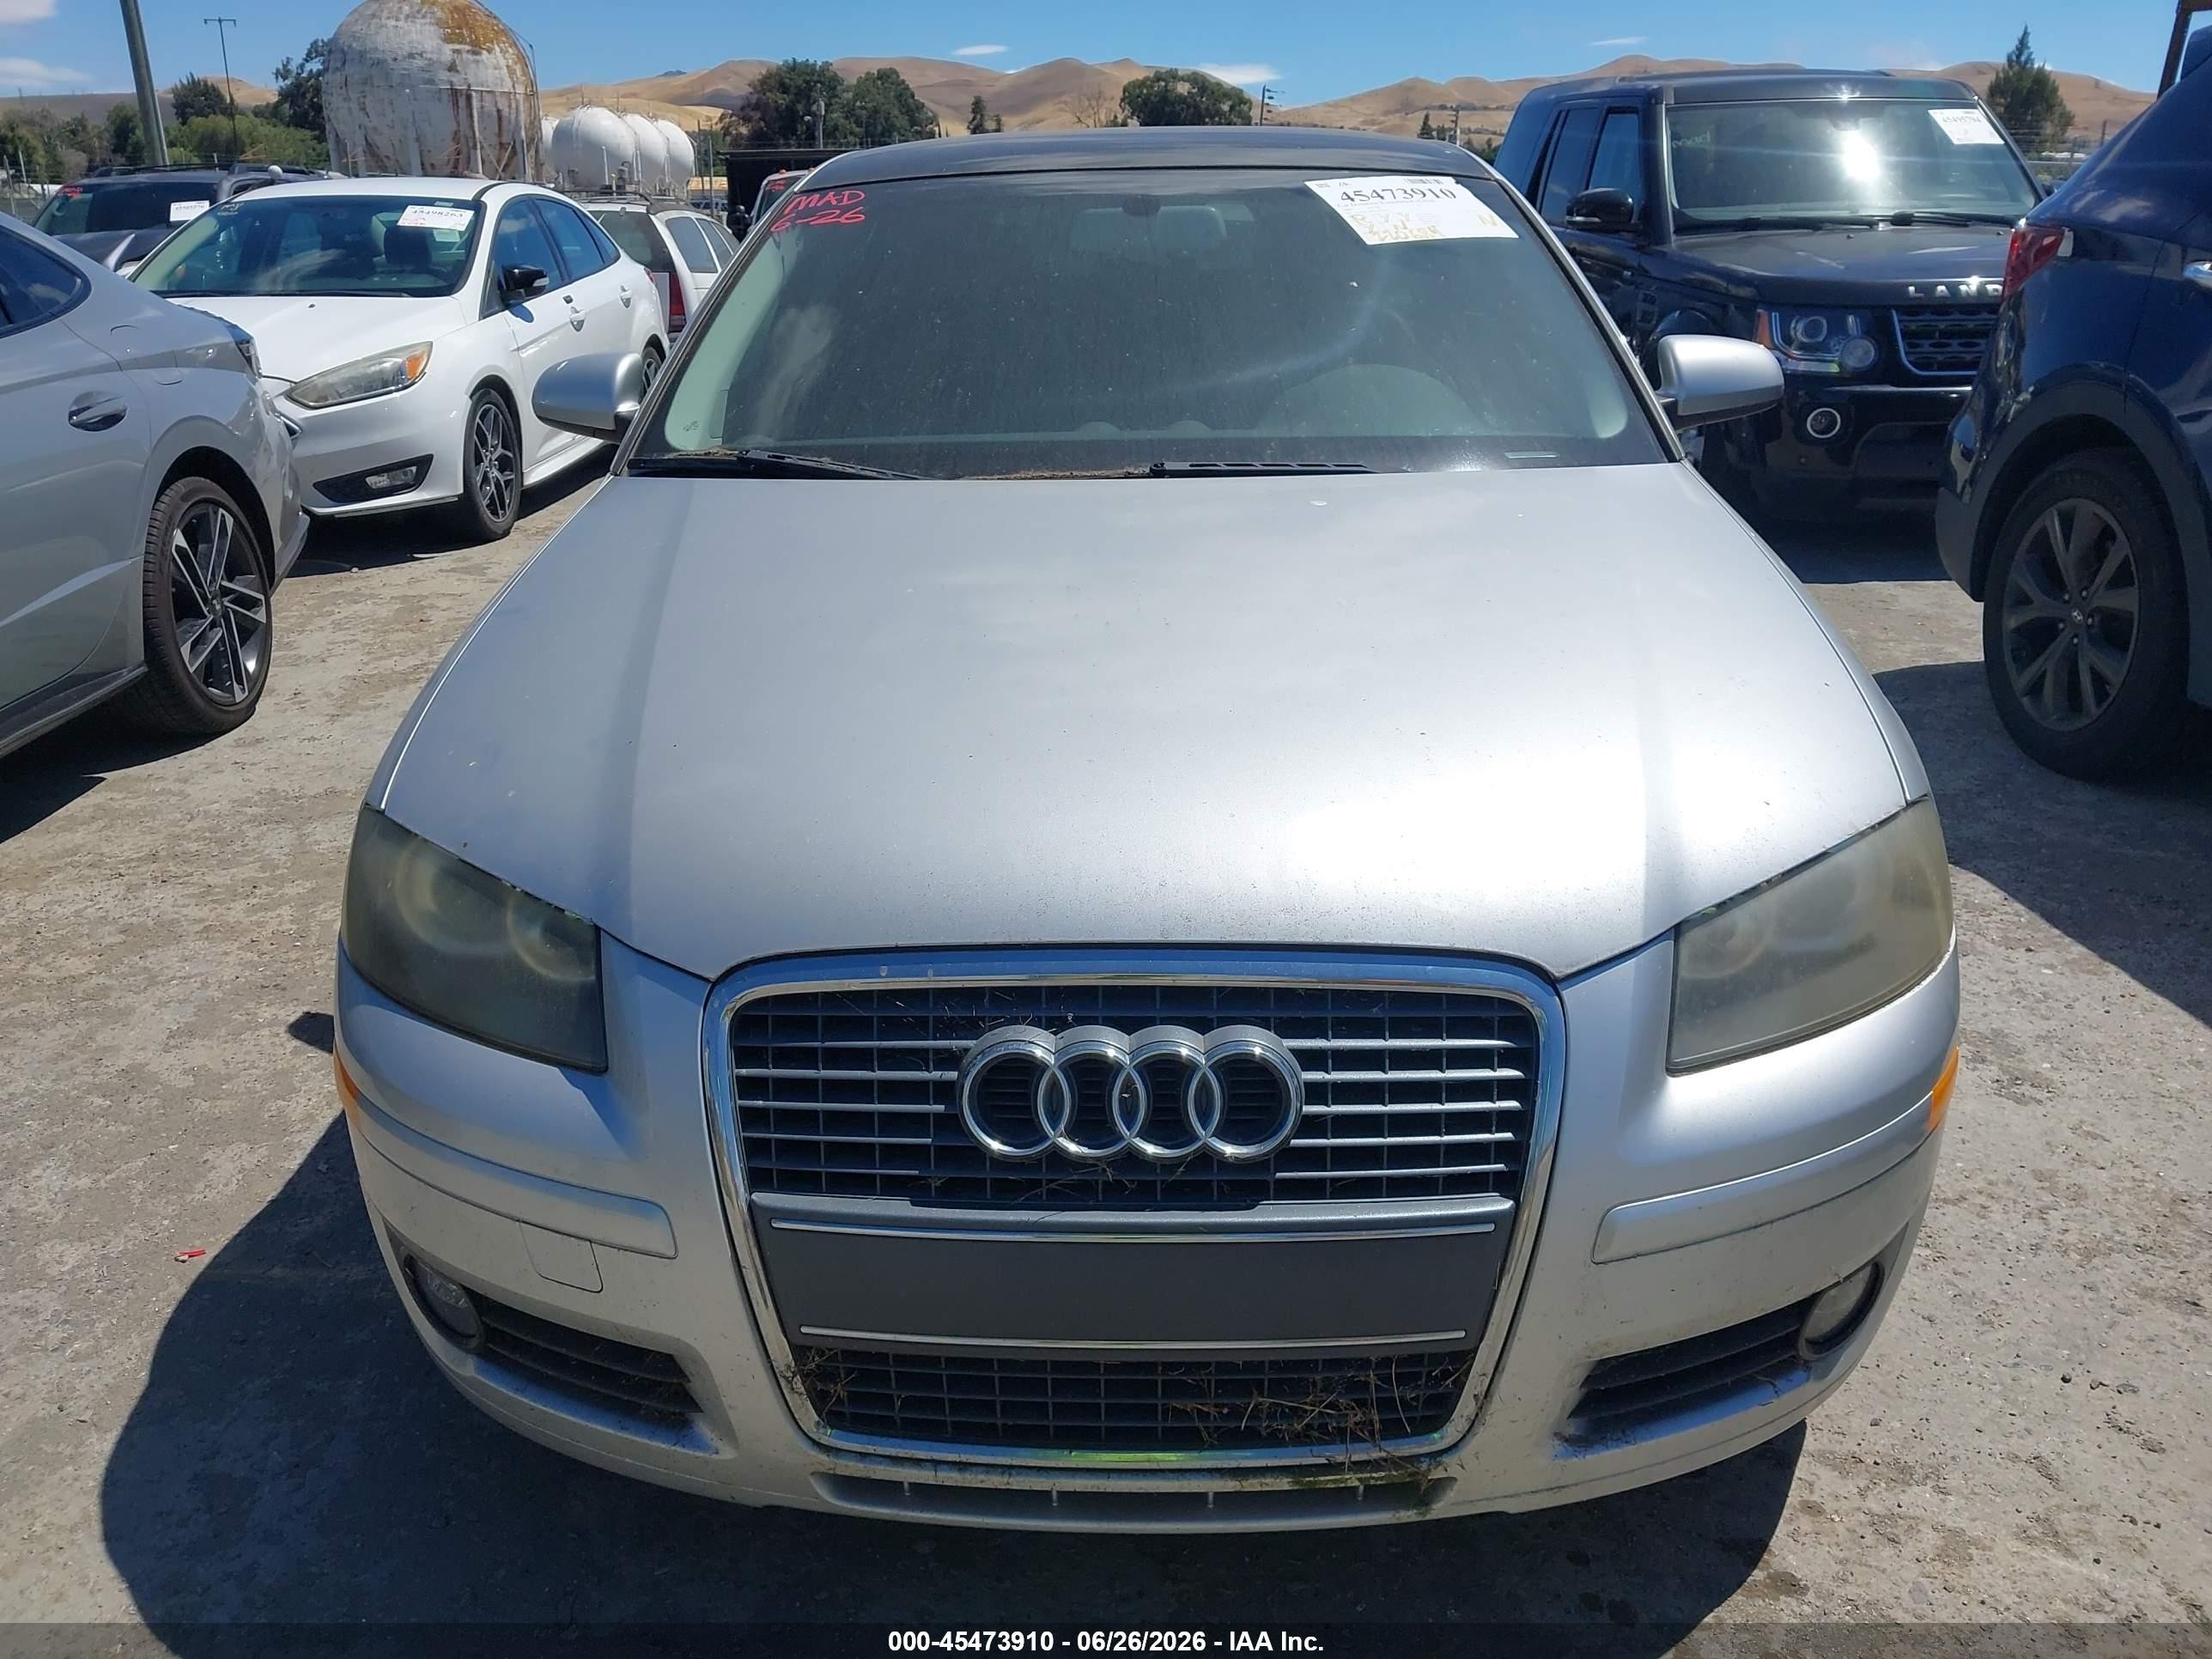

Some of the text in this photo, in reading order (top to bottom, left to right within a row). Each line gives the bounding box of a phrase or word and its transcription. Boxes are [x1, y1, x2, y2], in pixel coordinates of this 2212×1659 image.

[782, 191, 866, 214] MAD
[1340, 188, 1456, 203] 45473910
[769, 206, 866, 232] 6-26
[1908, 284, 2003, 298] LAND
